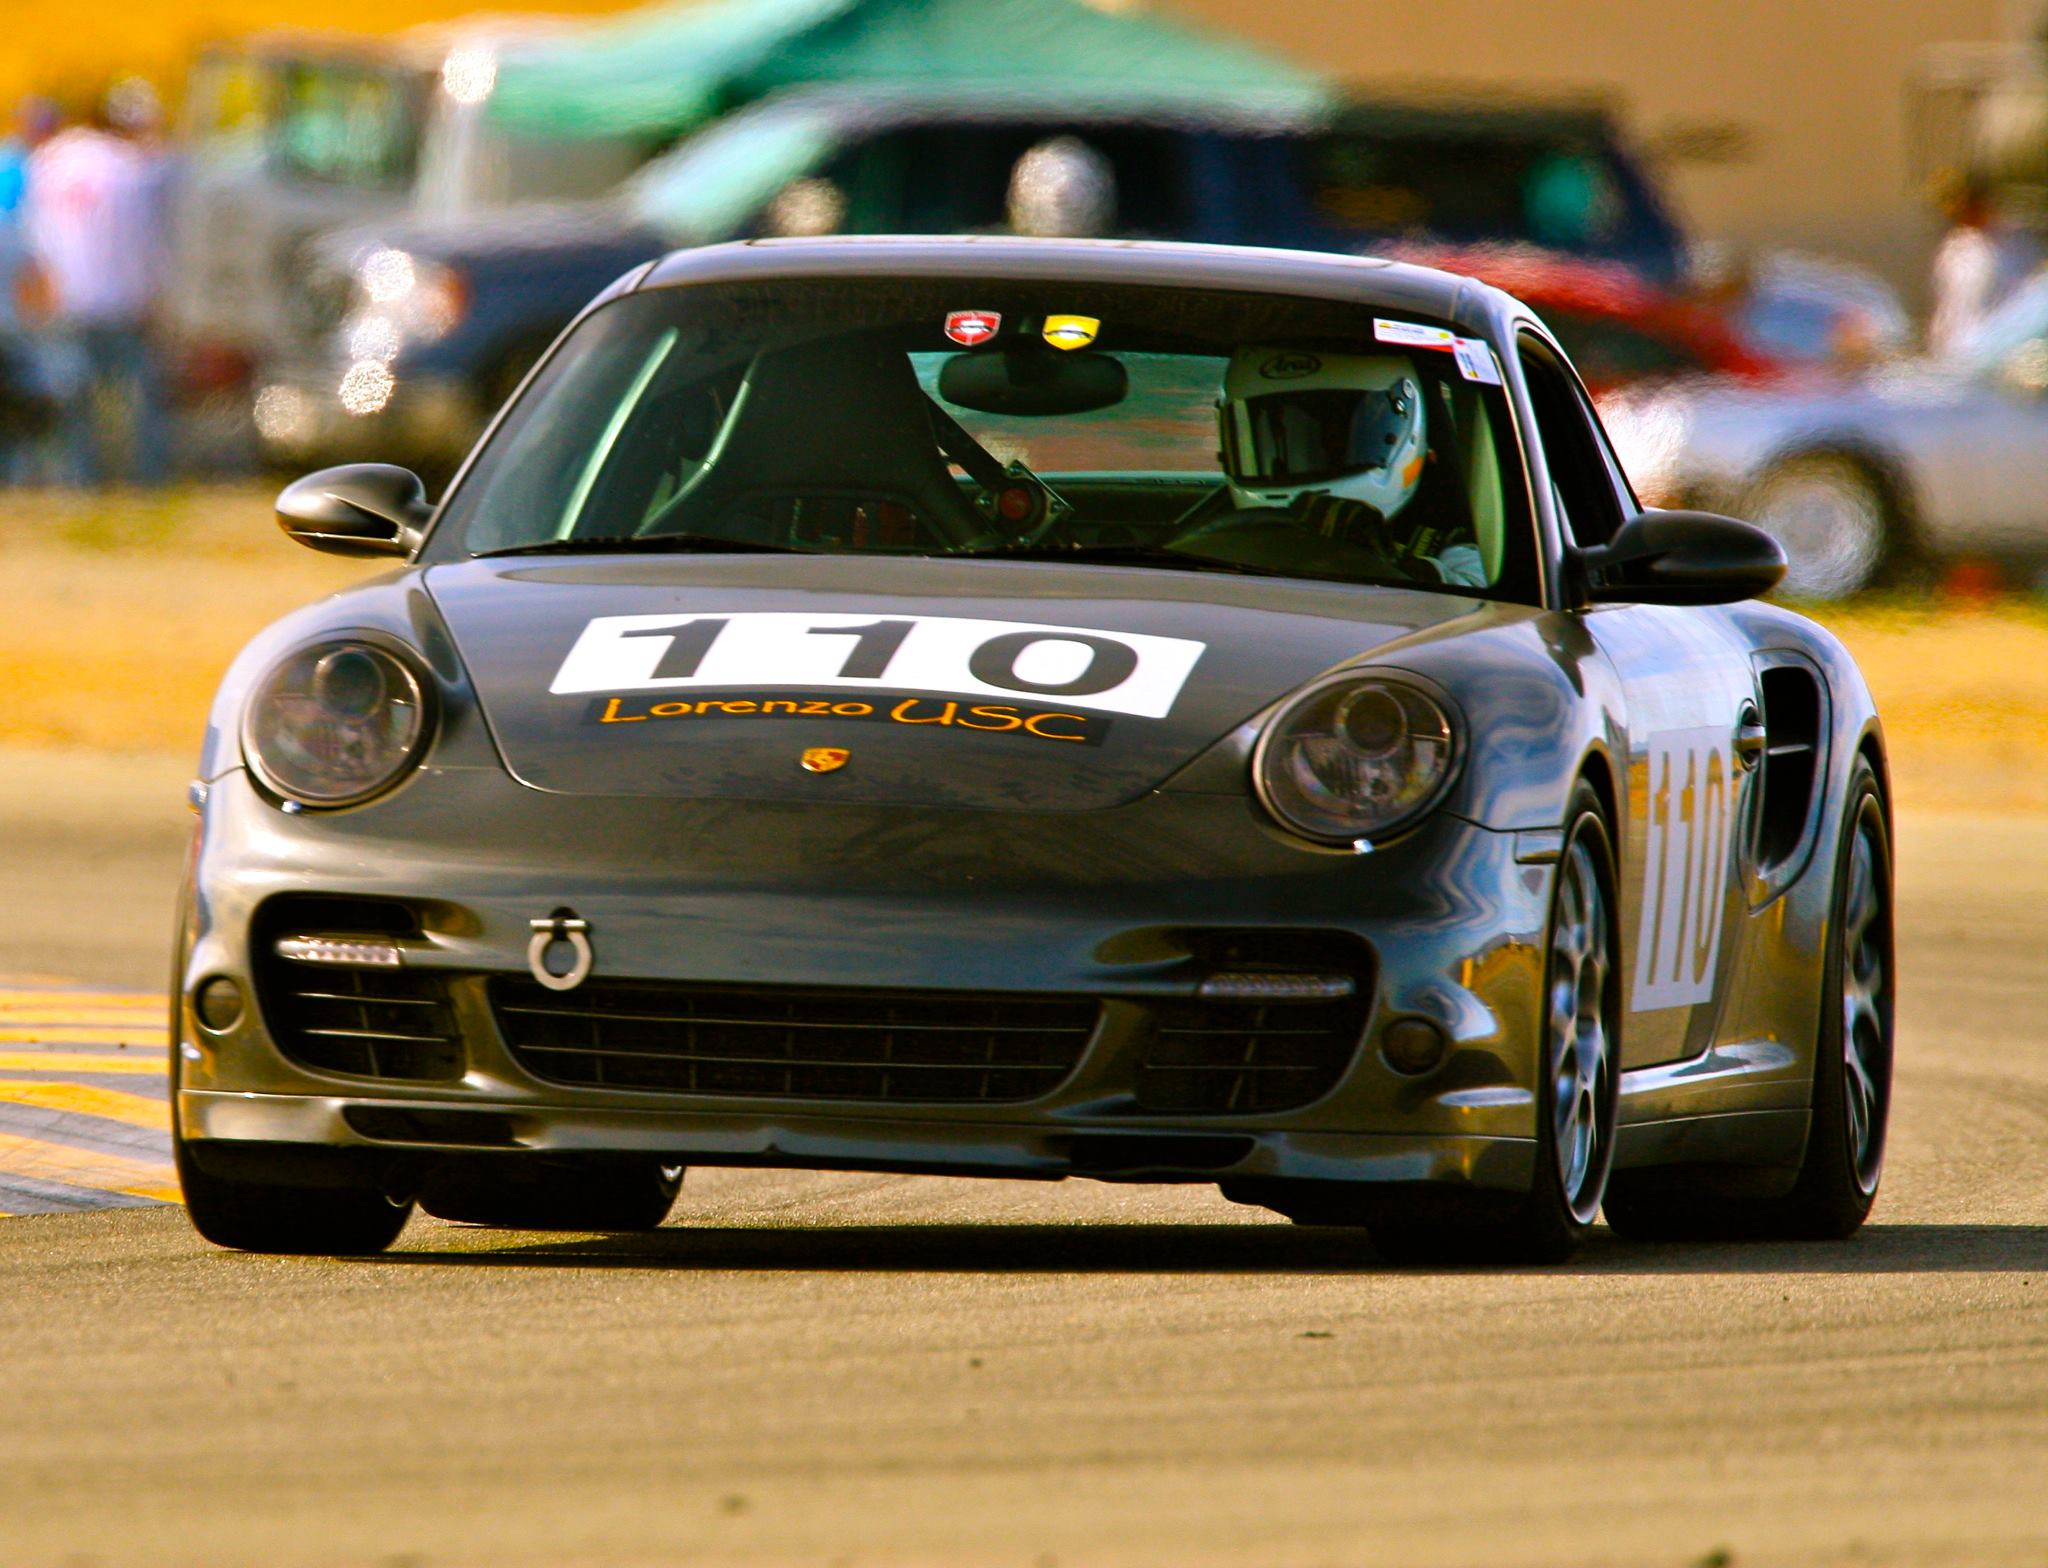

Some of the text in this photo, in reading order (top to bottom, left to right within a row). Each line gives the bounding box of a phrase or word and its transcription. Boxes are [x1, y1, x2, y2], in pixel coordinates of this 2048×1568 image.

[620, 618, 1138, 696] 110
[601, 698, 1088, 741] Lorenzo USC
[1648, 747, 1725, 986] 110
